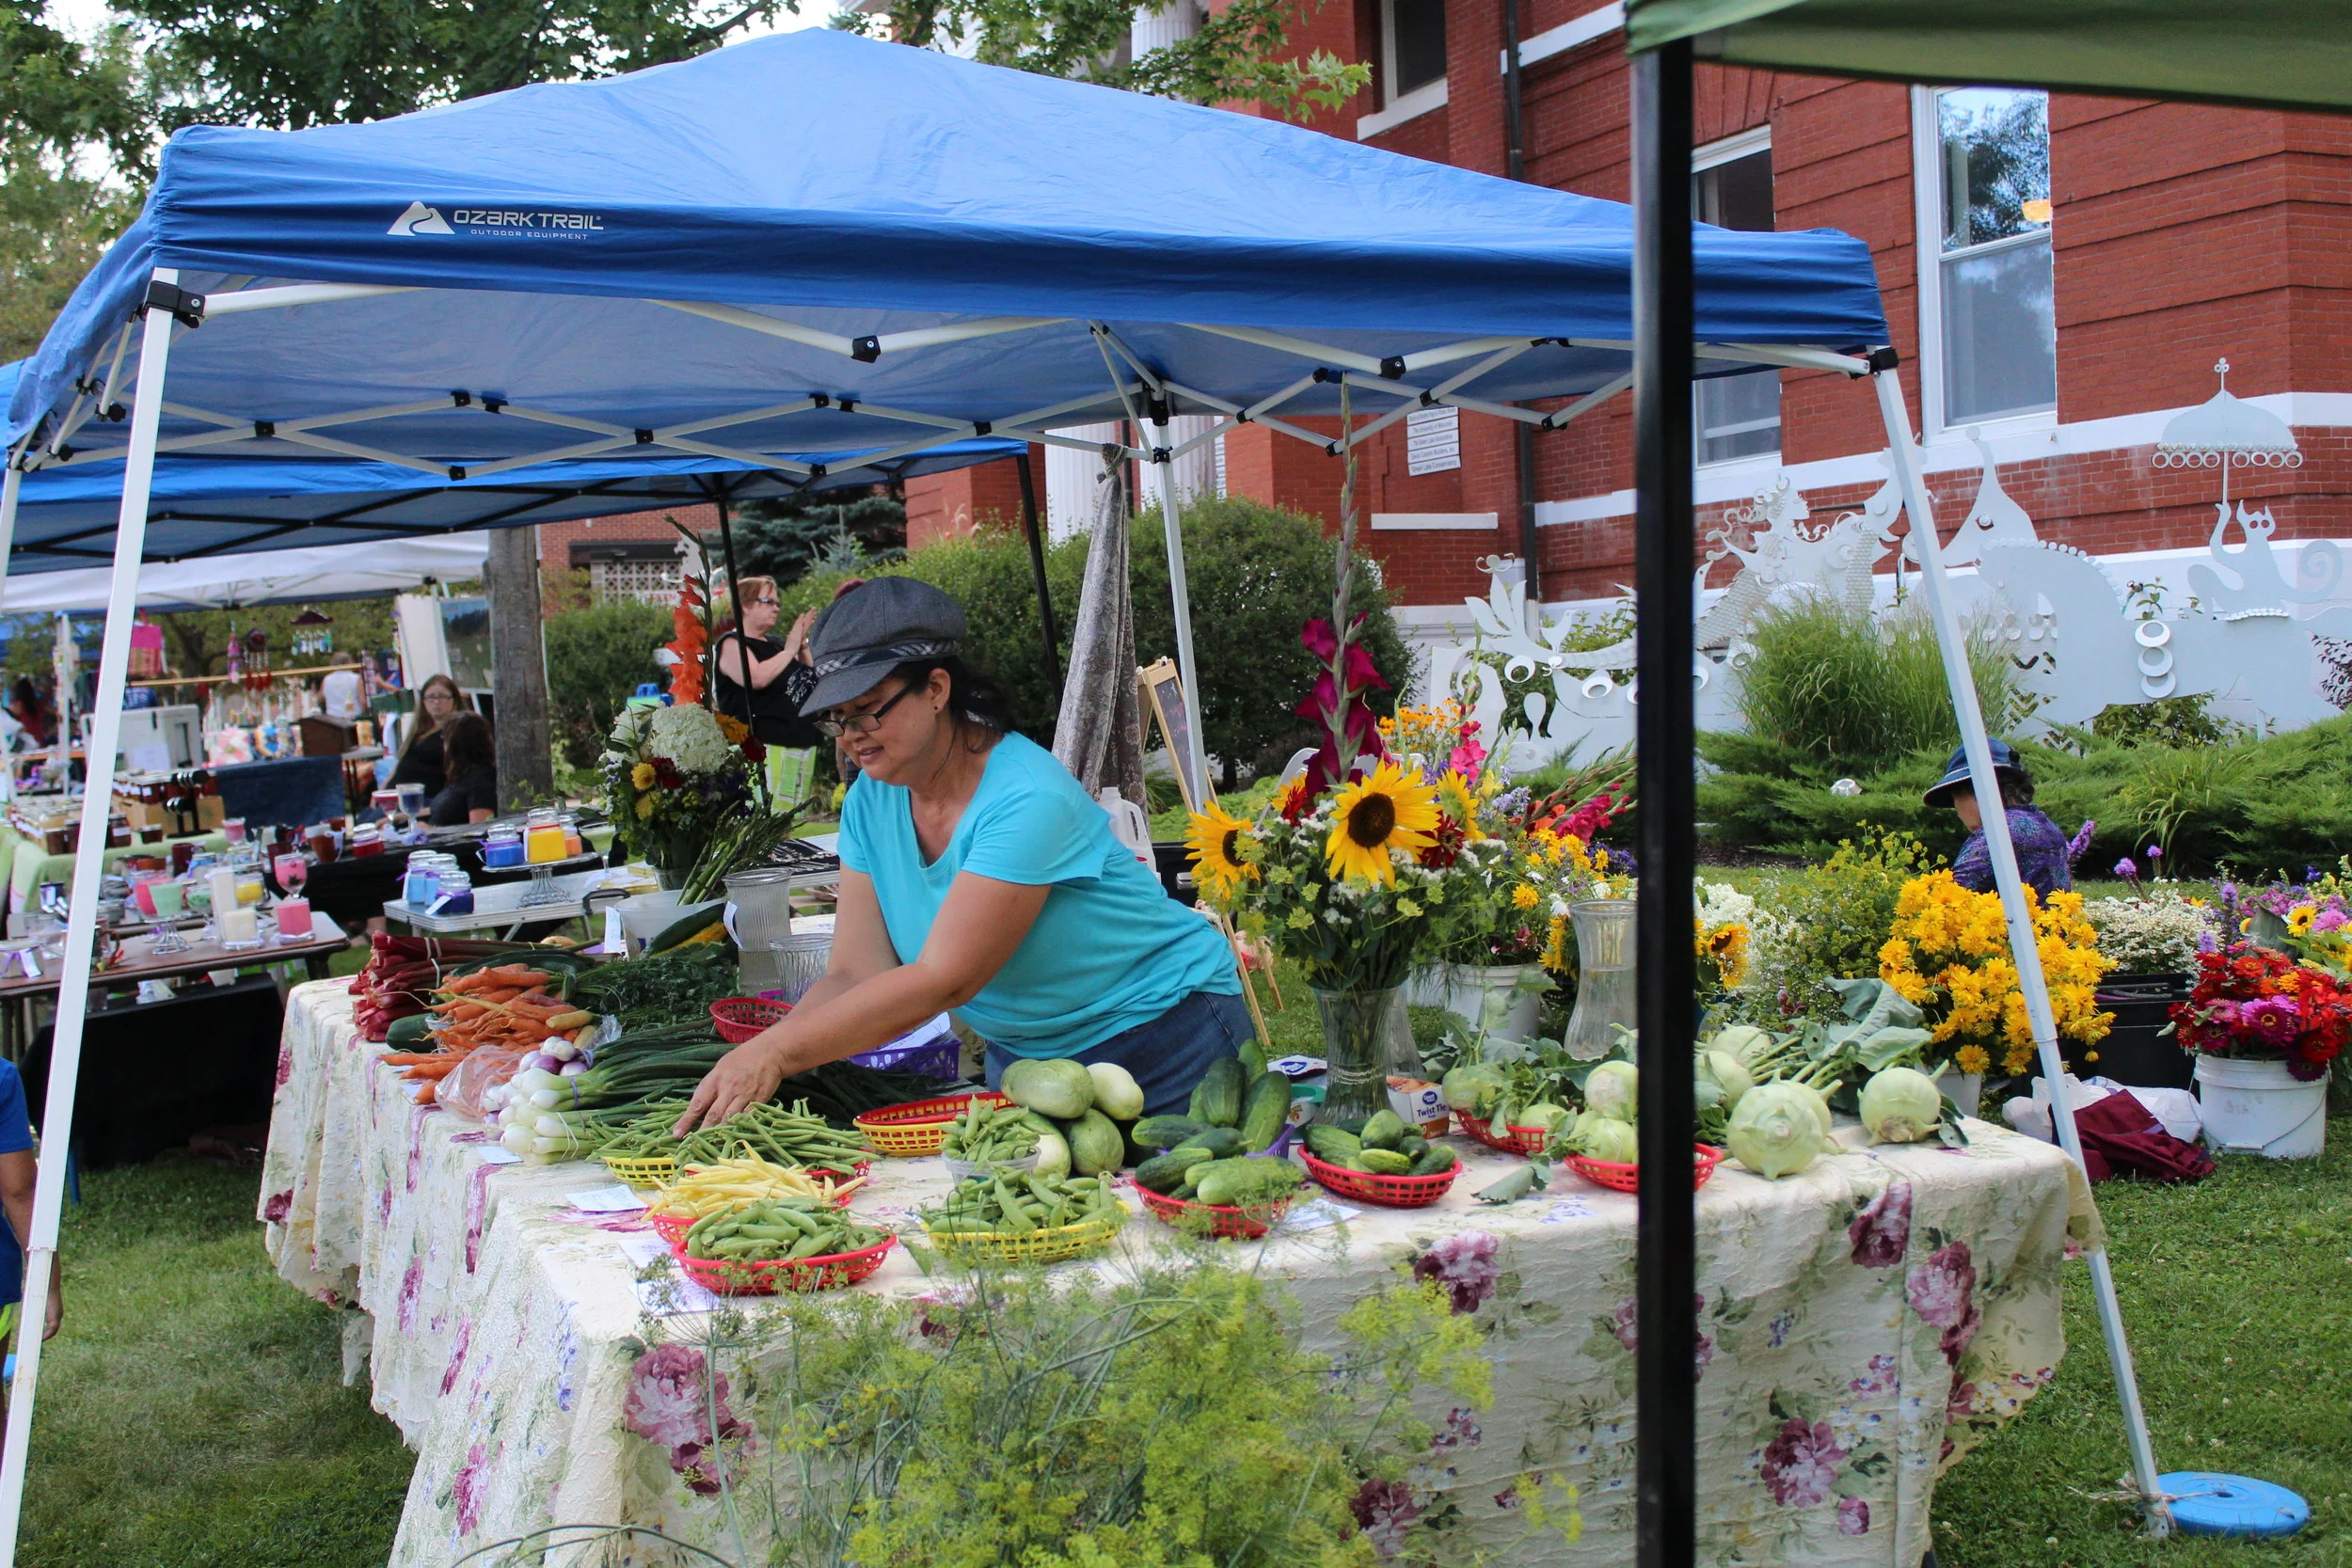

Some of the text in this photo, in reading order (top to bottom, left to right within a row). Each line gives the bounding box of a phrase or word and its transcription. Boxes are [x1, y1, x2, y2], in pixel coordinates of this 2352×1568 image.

[453, 210, 534, 228] OZARK
[470, 229, 588, 241] OUTDOOR EQUIPMENT
[1417, 1104, 1447, 1117] Twist Tie
